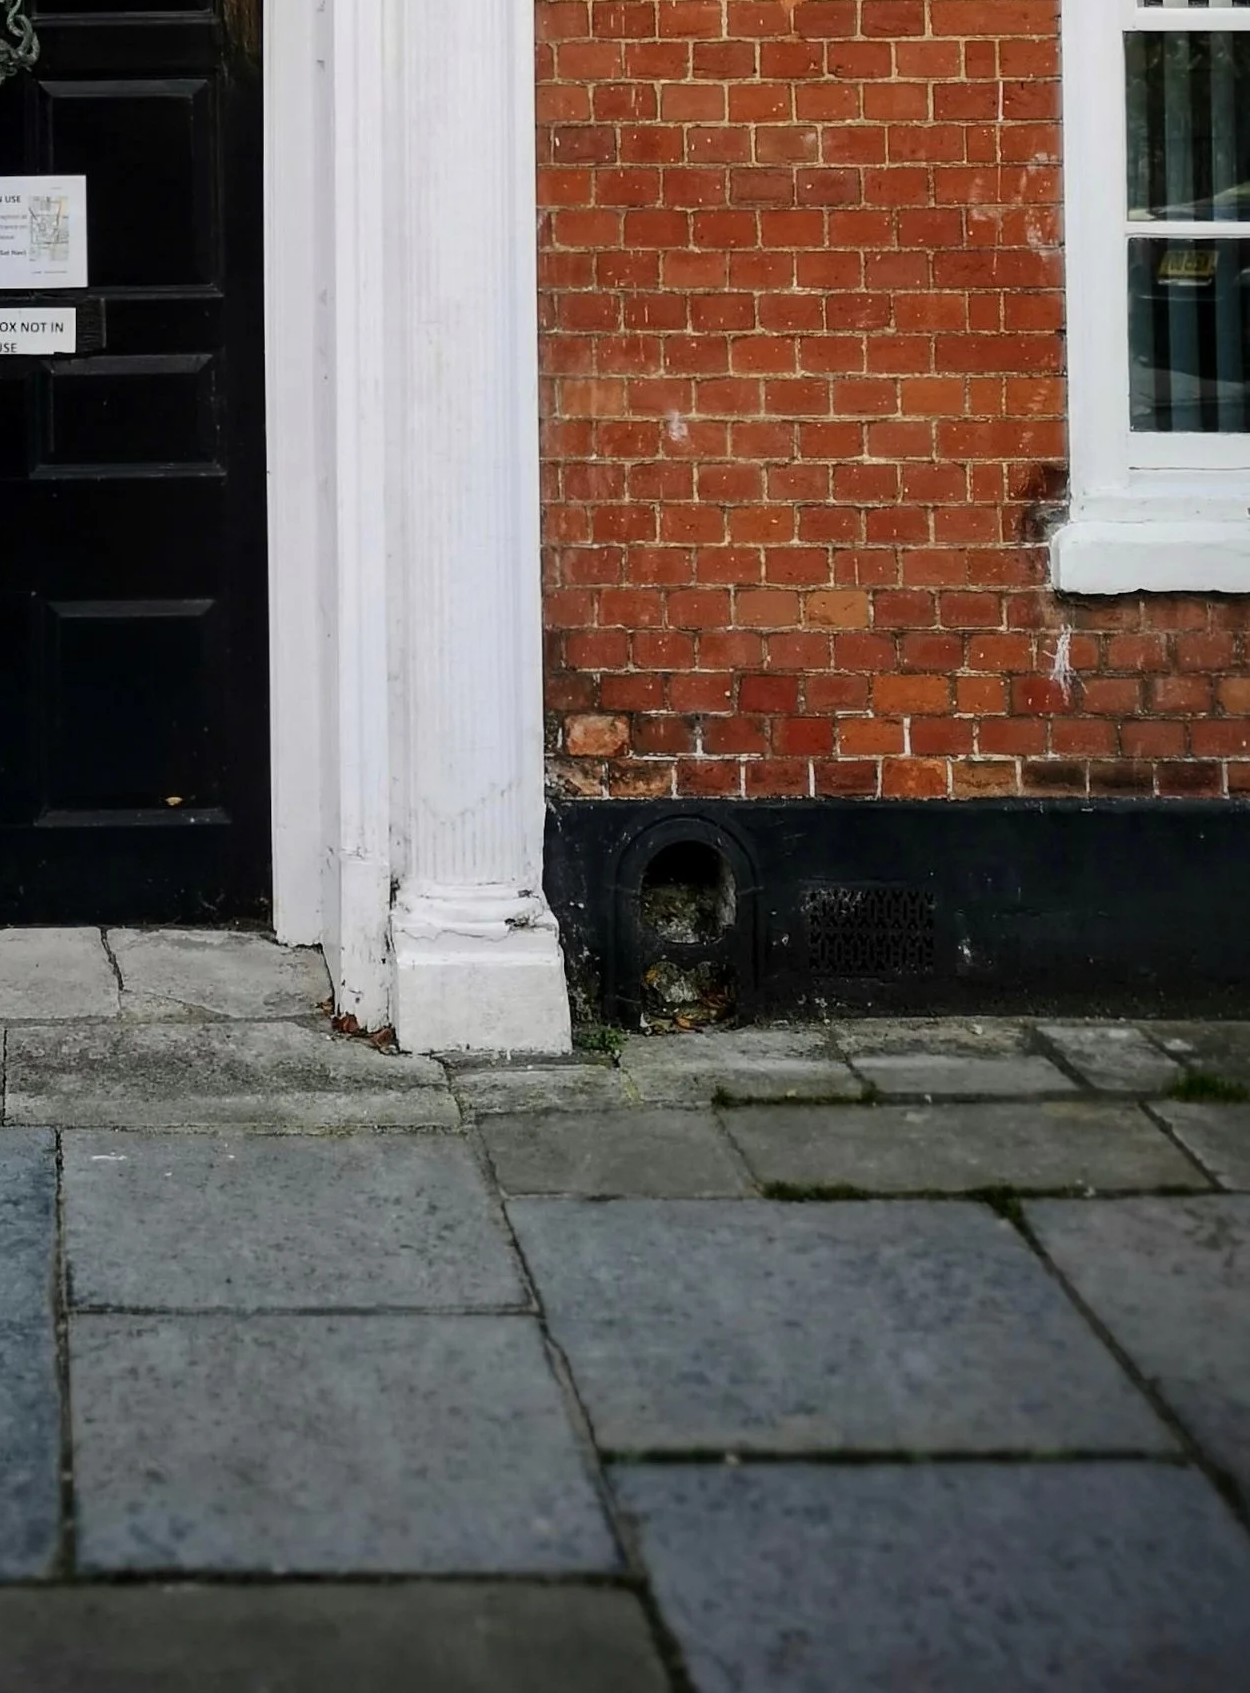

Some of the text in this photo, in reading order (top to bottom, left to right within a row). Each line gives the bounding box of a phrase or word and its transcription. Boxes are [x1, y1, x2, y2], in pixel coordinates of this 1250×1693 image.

[5, 195, 21, 203] USE
[20, 322, 47, 332] NOT
[51, 322, 64, 333] IN
